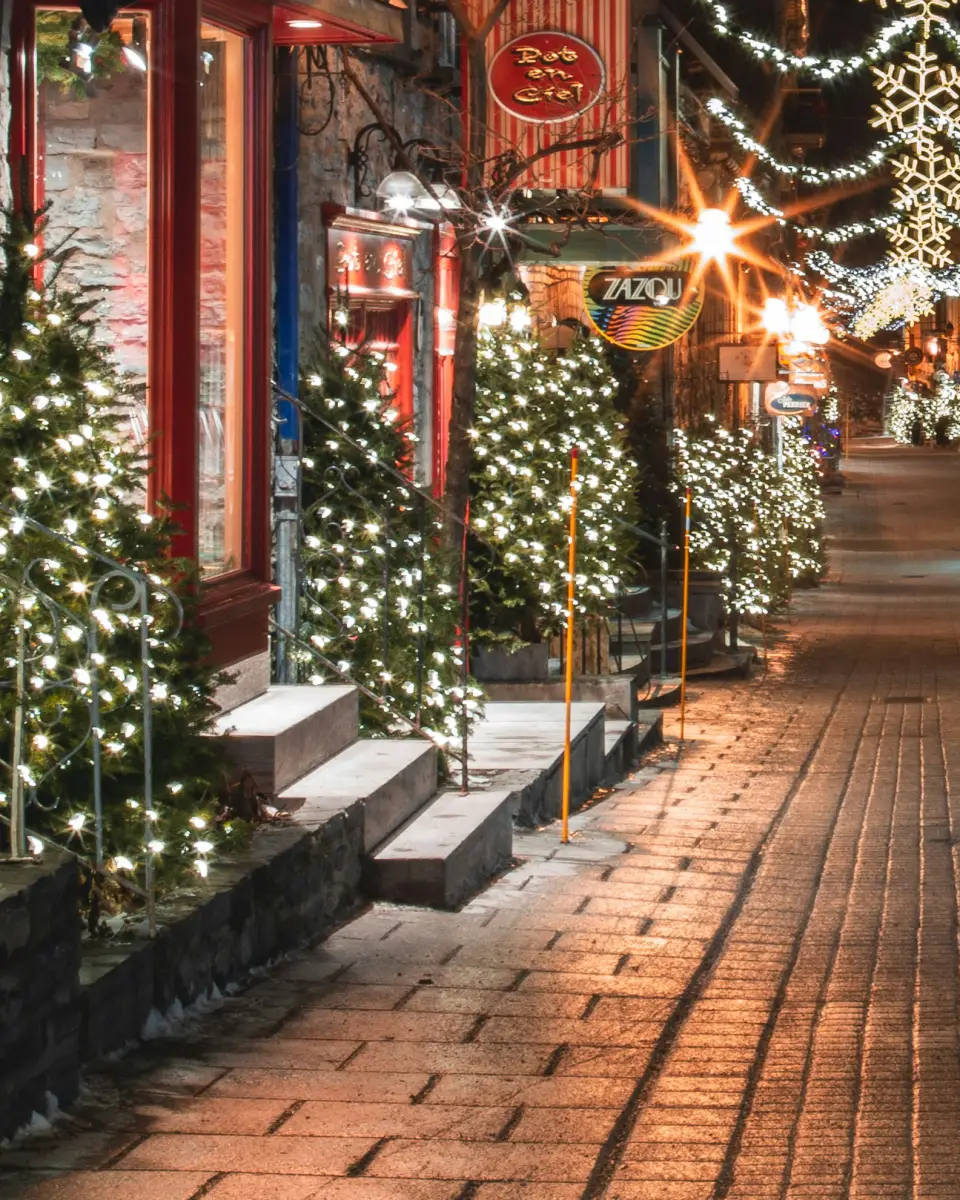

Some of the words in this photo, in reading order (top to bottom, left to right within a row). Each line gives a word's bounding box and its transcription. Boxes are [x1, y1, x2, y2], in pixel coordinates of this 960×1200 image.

[514, 45, 578, 64] Pot
[527, 67, 573, 80] en
[514, 82, 584, 102] Ciel
[603, 277, 682, 301] ZAZOU
